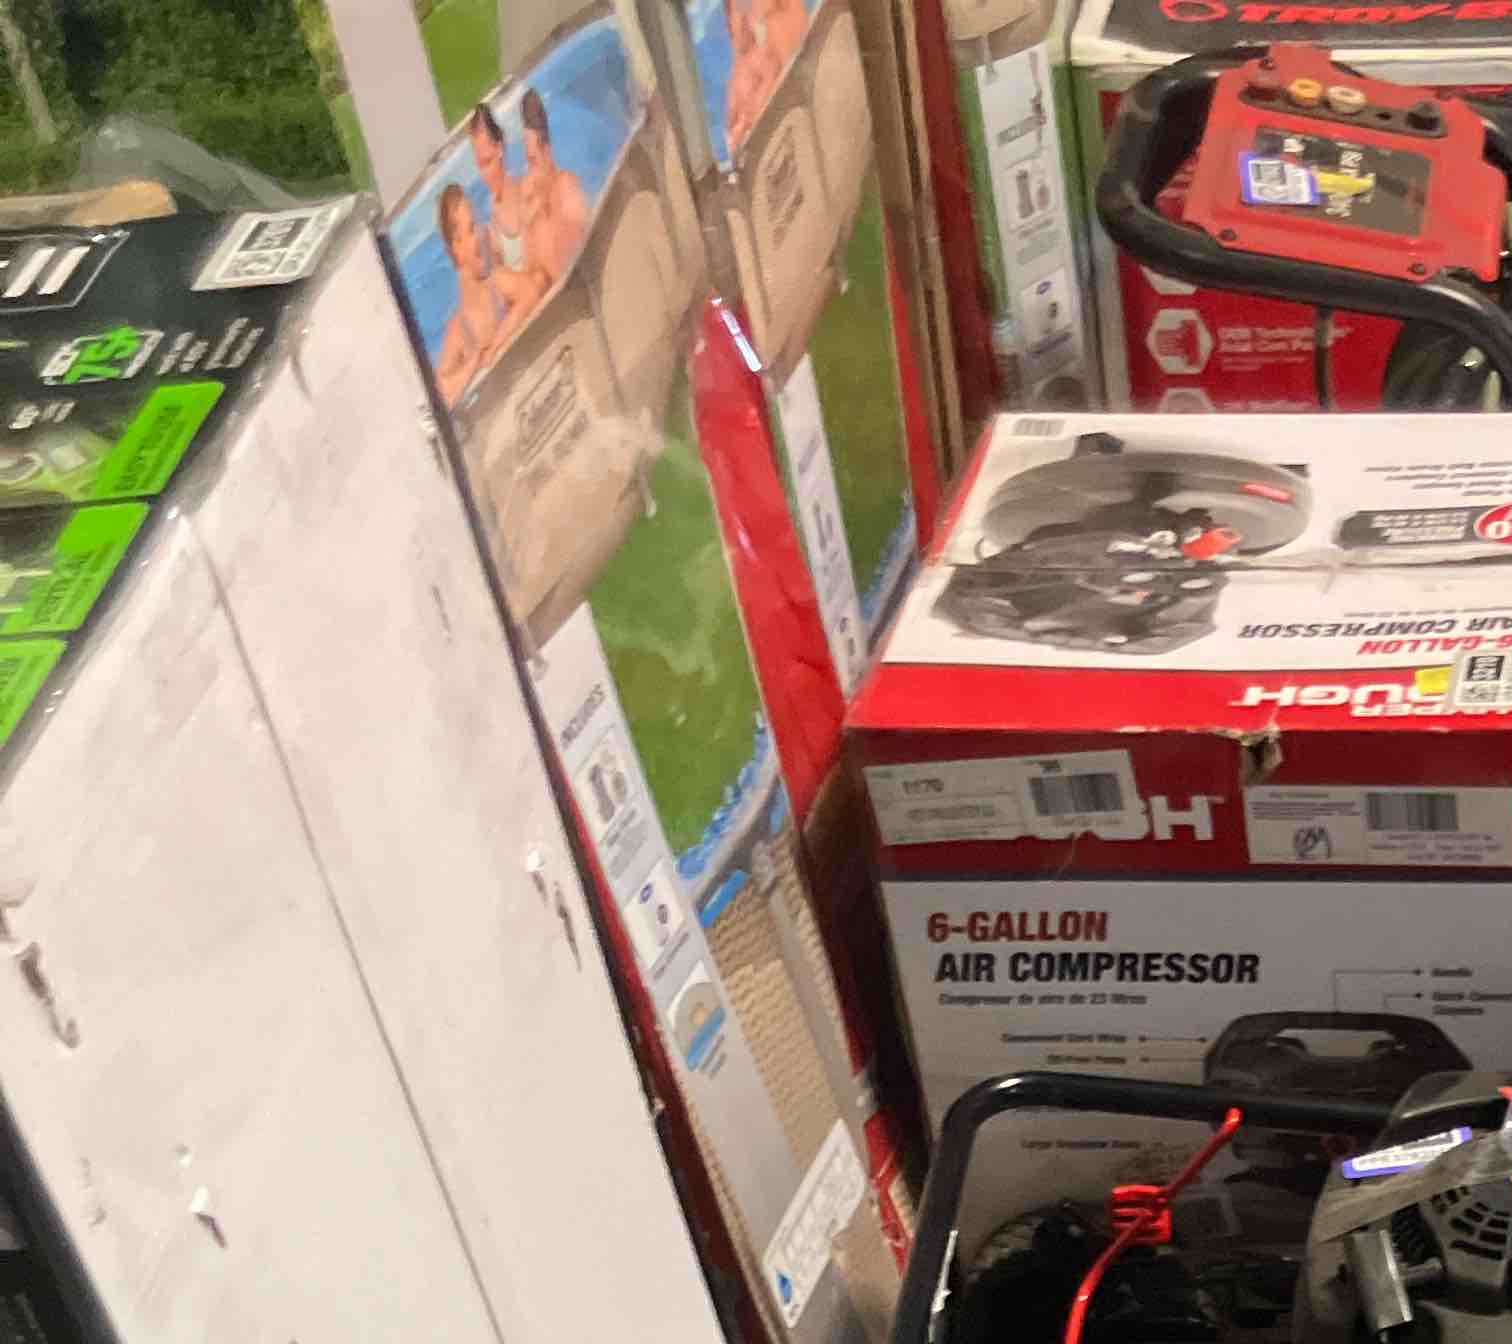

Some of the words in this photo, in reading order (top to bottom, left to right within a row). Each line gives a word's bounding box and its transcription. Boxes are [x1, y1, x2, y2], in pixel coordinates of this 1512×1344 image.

[1238, 618, 1460, 640] COMPRESSOR
[927, 910, 1109, 944] 6-GALLON
[935, 952, 996, 985] AIR
[1008, 951, 1261, 985] COMPRESSOR
